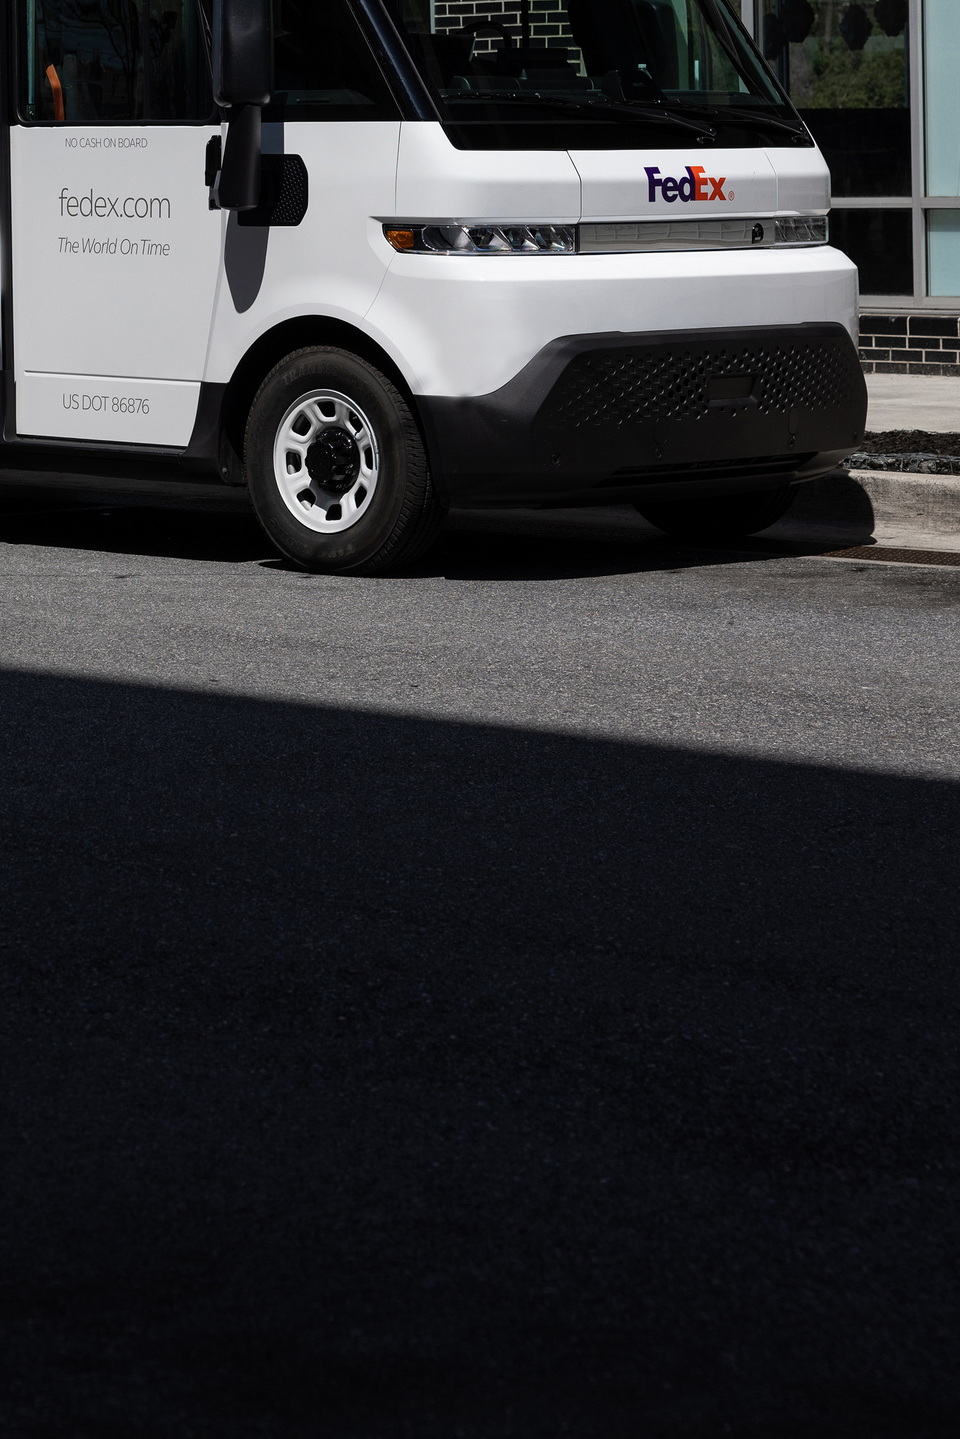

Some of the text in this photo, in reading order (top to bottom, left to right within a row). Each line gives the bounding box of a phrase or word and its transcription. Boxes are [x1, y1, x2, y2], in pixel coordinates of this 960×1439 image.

[65, 138, 148, 148] NO CASH ON BOARD
[643, 165, 727, 203] FedEx
[58, 187, 171, 219] fedex.com
[58, 237, 171, 257] The World On Time
[62, 393, 150, 415] US DOT 86876
